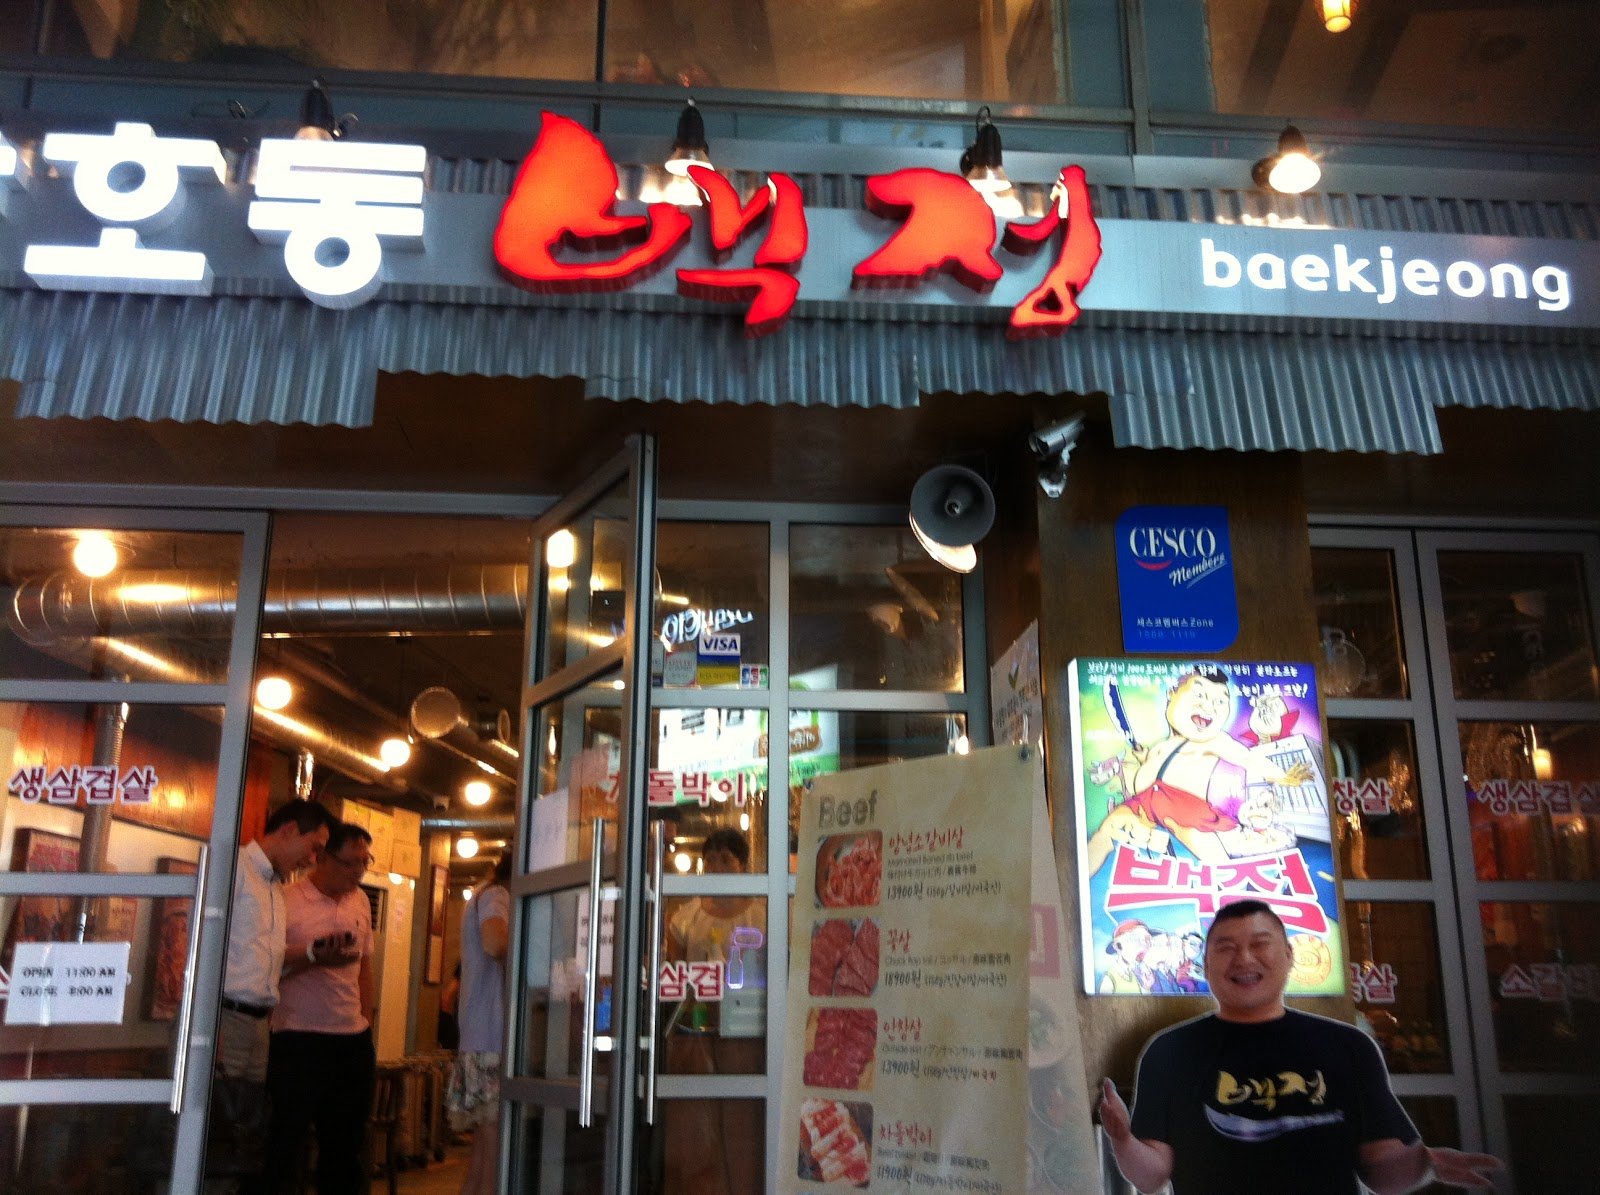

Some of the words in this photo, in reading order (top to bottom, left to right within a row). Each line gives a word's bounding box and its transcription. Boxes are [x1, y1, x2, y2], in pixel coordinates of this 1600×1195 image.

[0, 121, 428, 306] 호동
[494, 110, 1102, 332] 백정
[1201, 239, 1571, 311] baekjeong
[1129, 526, 1216, 558] CESCO
[1168, 552, 1226, 587] Members
[703, 638, 738, 651] VISA
[9, 766, 156, 804] 생삼겹살
[818, 790, 878, 829] Beef
[1105, 845, 1331, 934] 백정
[22, 966, 54, 979] OPEN
[99, 966, 116, 978] AM
[97, 985, 113, 997] AM
[1217, 1070, 1327, 1112] 백정
